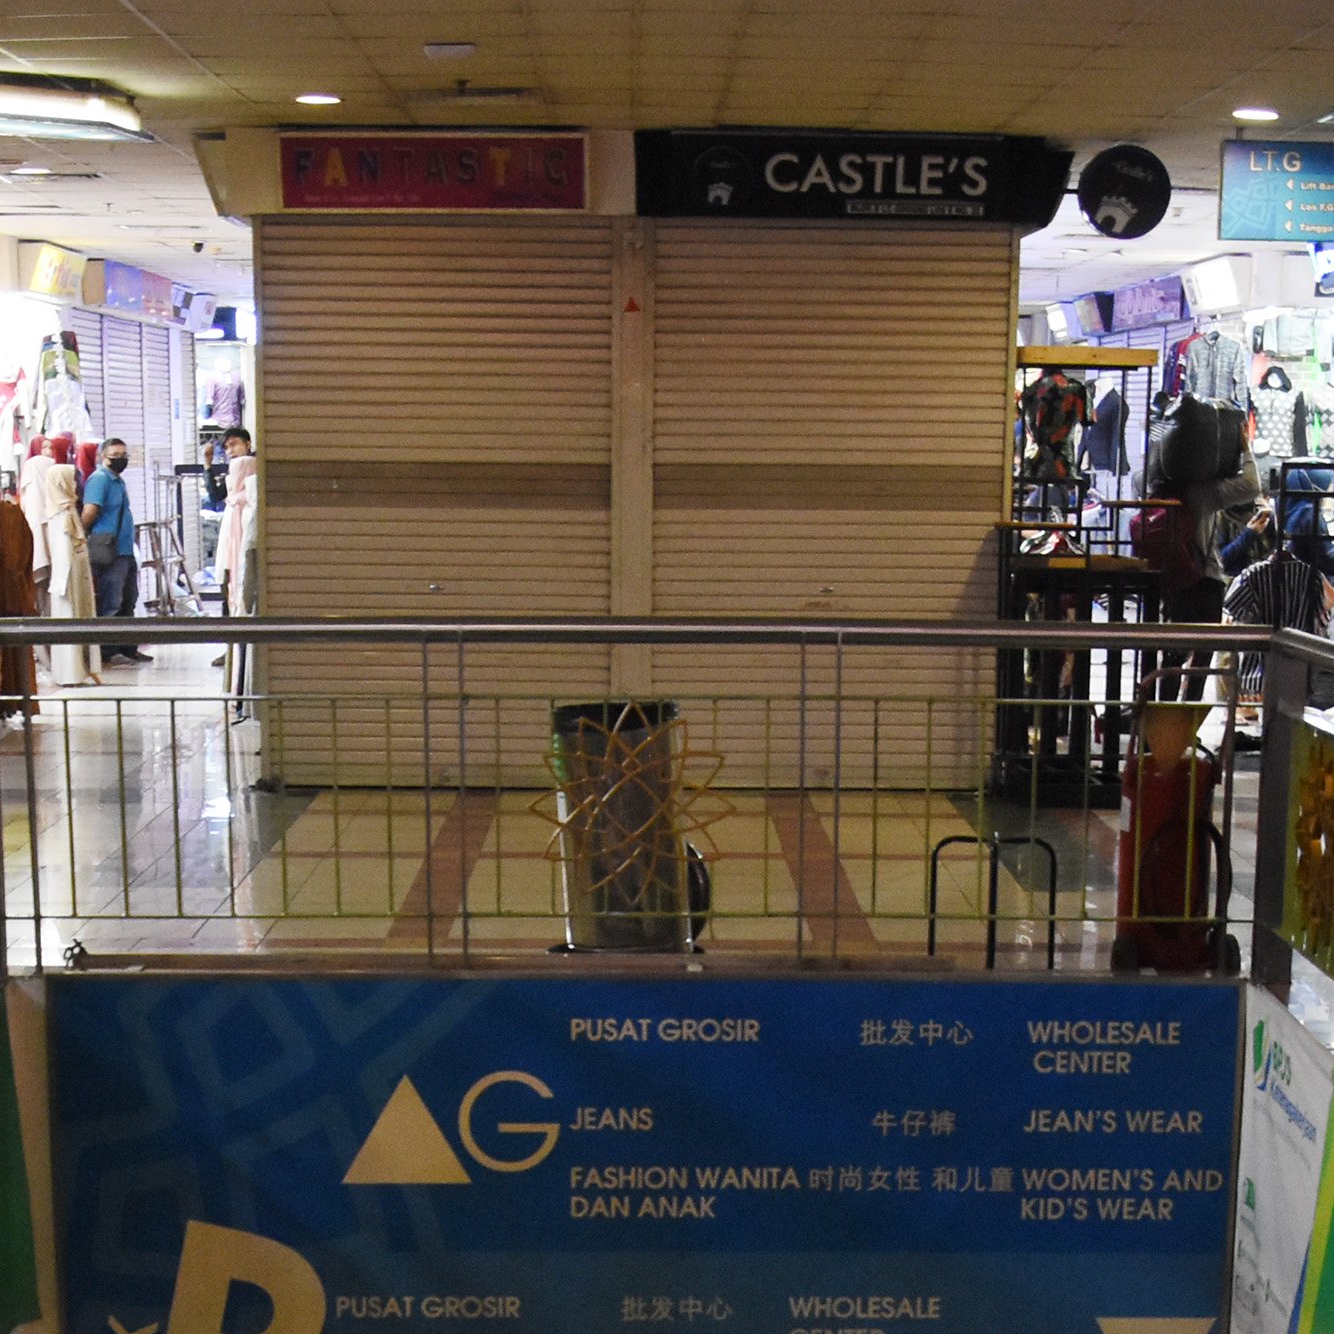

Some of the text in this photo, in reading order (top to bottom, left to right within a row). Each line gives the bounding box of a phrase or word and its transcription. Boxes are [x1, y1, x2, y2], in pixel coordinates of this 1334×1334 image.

[293, 146, 570, 188] FANTASTIC
[763, 152, 990, 197] CASTLE'S
[570, 1018, 761, 1042] PUSAT GROSIR
[860, 1019, 975, 1047] 批发中心
[1027, 1021, 1182, 1045] WHOLESALE
[1033, 1050, 1132, 1075] CENTER
[457, 1069, 560, 1173] G
[569, 1107, 654, 1131] JEANS
[871, 1109, 958, 1138] 牛仔裤
[1023, 1109, 1204, 1134] JEAN'S WEAR
[570, 1166, 801, 1191] FASHION WANITA
[808, 1166, 1015, 1192] 时尚女性 和儿童
[1022, 1167, 1224, 1192] WOMEN'S AND
[570, 1195, 716, 1219] DAN ANAK
[1021, 1197, 1174, 1221] KID'S WEAR
[335, 1295, 521, 1320] PUSAT GROSIR
[621, 1295, 734, 1322] 批发中心
[789, 1296, 942, 1320] WHOLESALE
